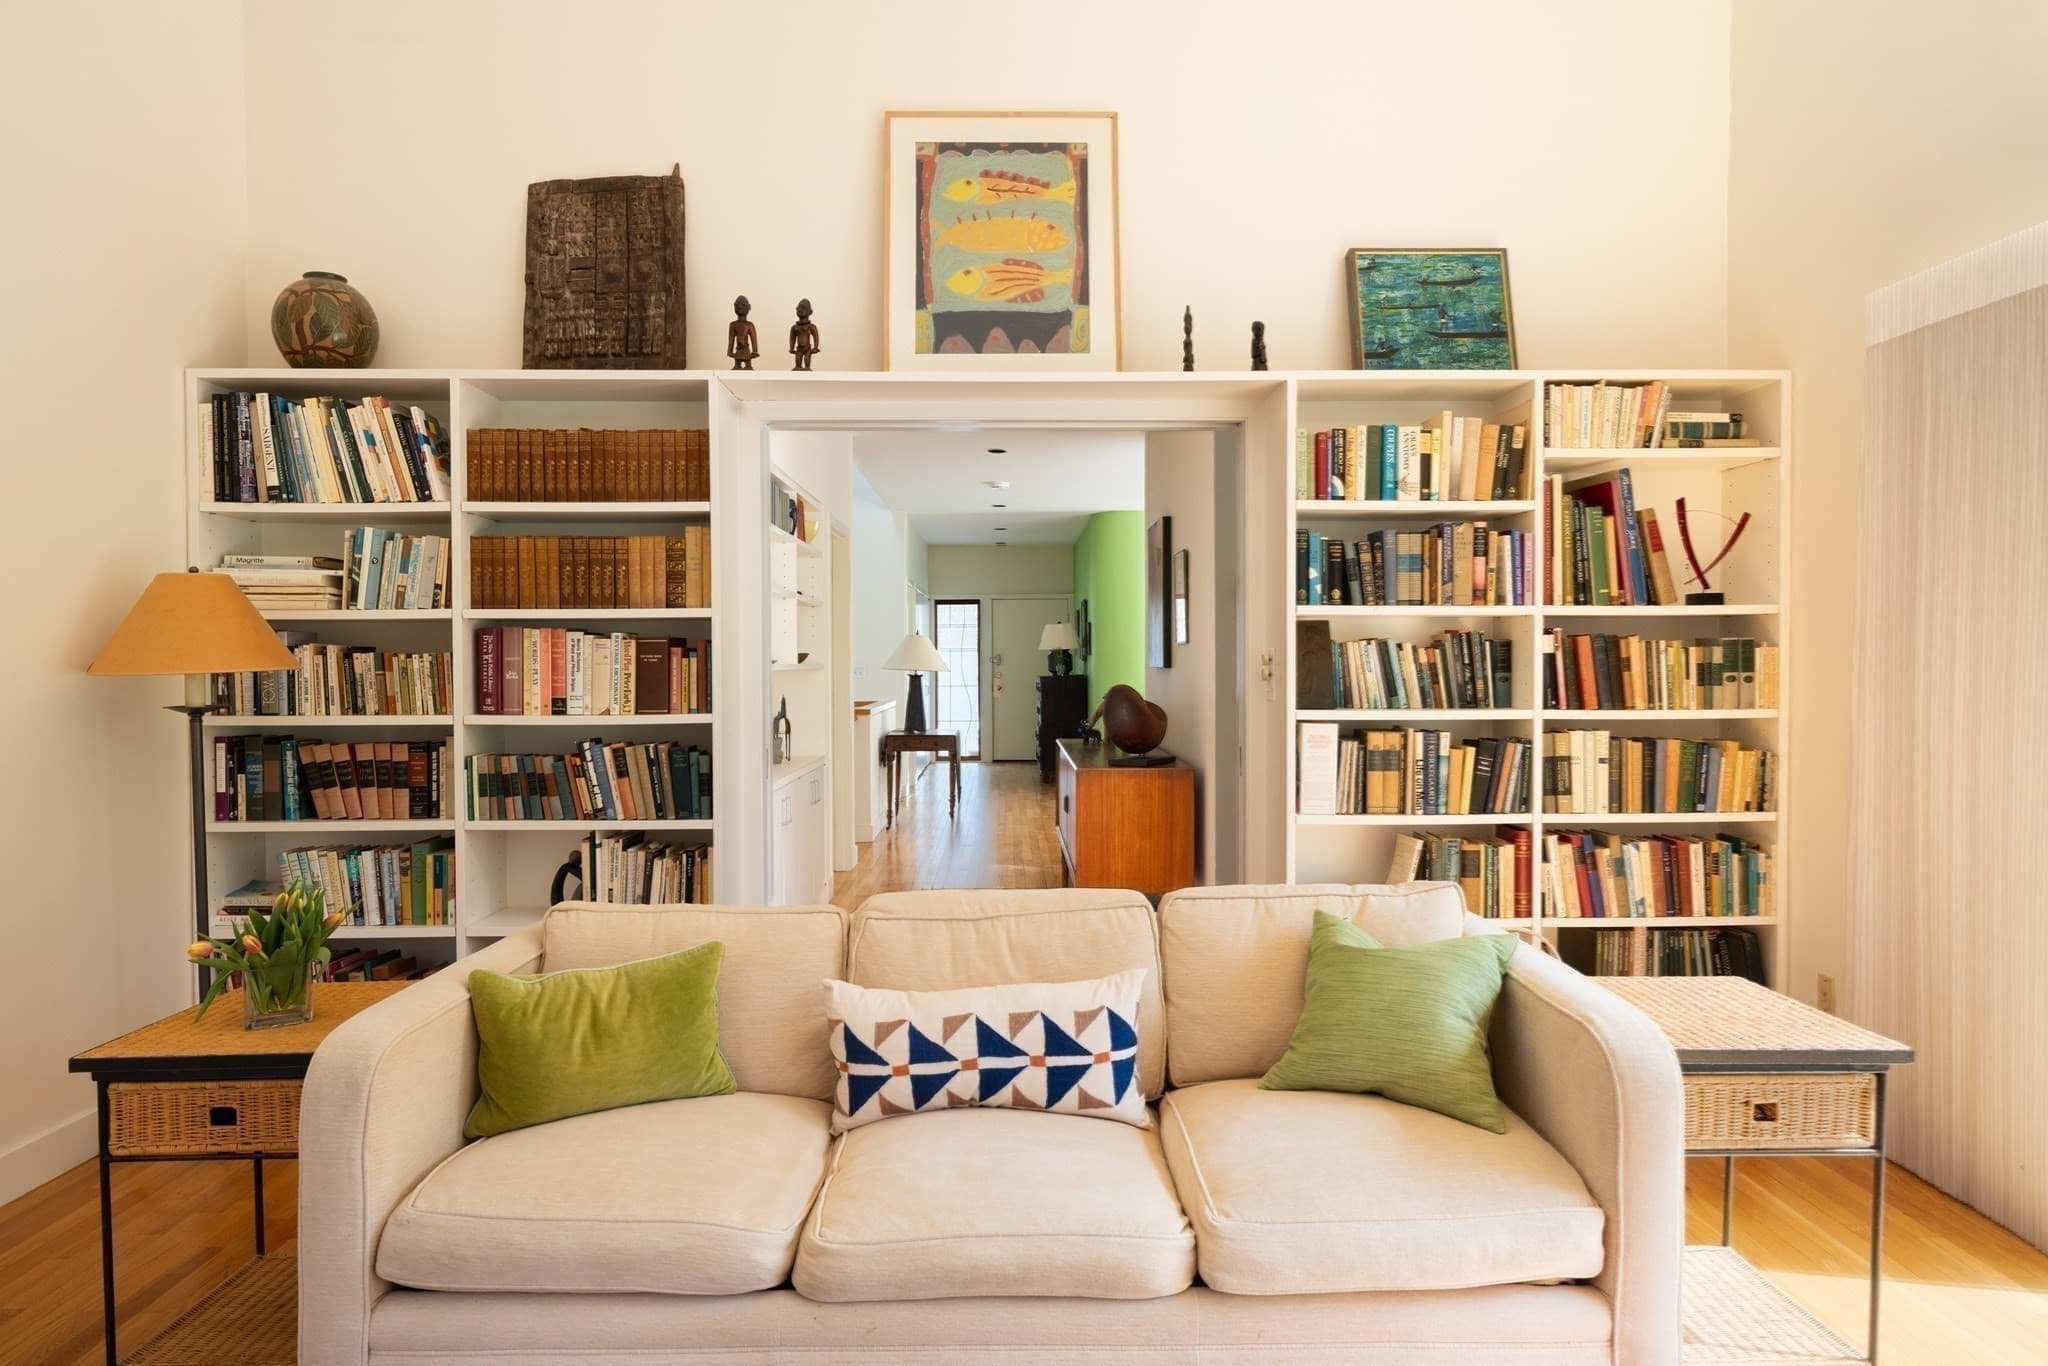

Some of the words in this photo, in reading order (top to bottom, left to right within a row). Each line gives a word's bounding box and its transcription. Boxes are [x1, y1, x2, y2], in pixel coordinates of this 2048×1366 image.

[263, 428, 275, 473] SARGENT
[1386, 429, 1395, 463] COUPLES
[235, 557, 265, 565] Magritte
[623, 672, 632, 688] Peter
[1426, 744, 1436, 804] KIERKEGAARD
